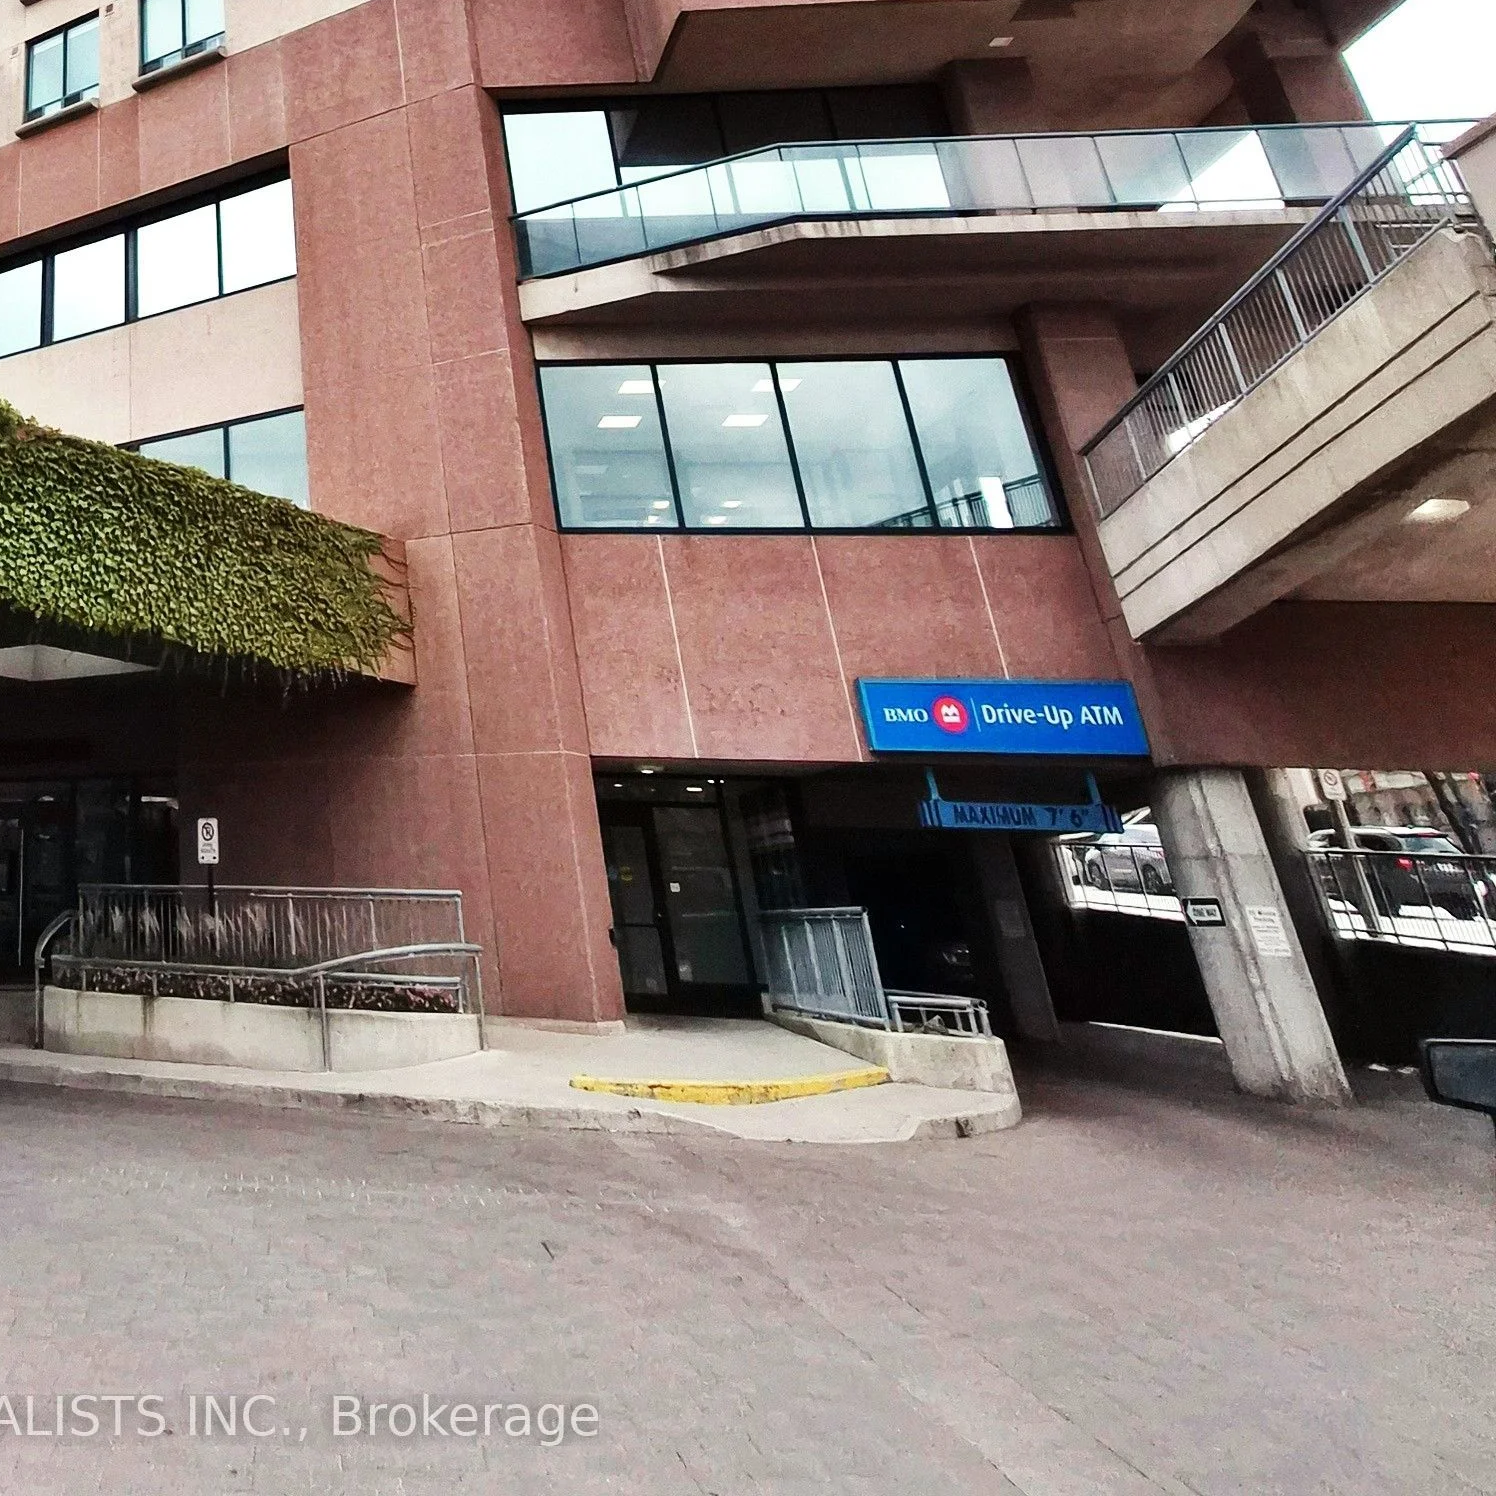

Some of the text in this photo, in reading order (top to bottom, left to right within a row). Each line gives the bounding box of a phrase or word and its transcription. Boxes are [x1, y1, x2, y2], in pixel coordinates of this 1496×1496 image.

[884, 703, 1124, 730] BMO Drive-Up ATM
[954, 805, 1037, 825] MAXIMUM
